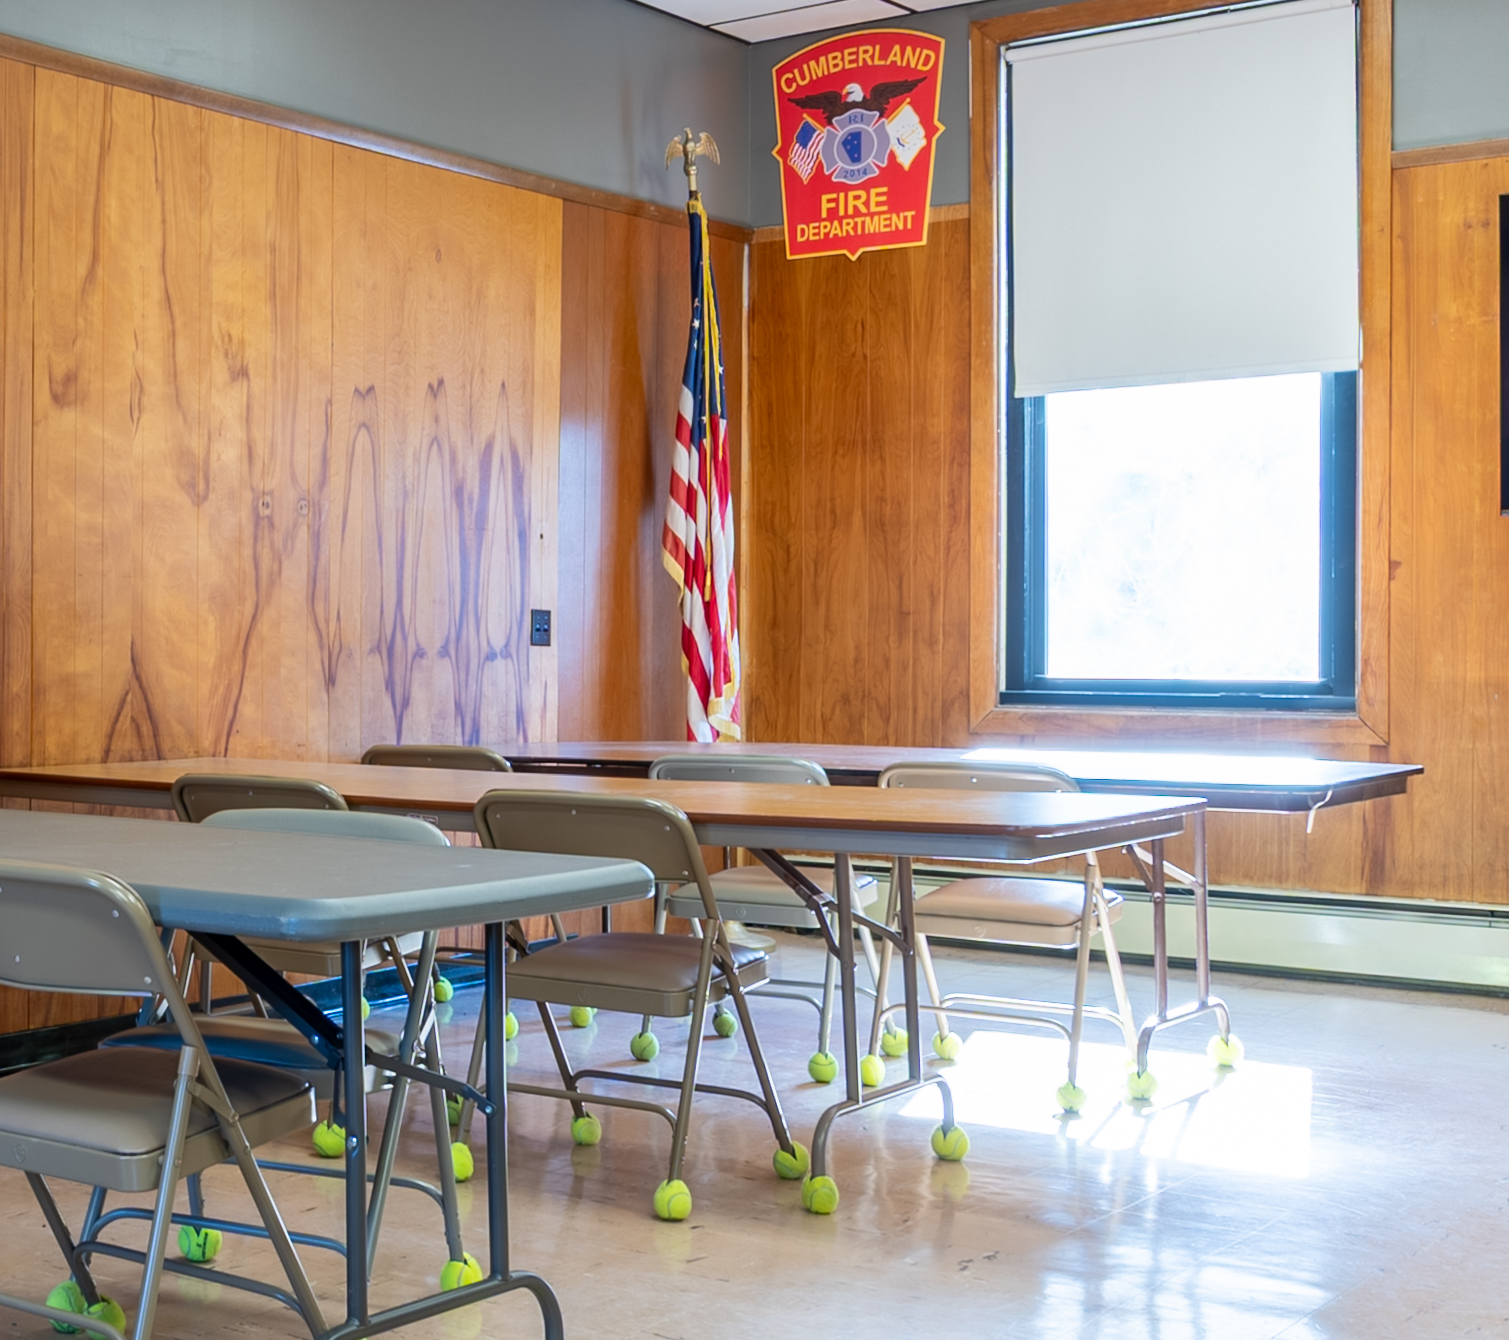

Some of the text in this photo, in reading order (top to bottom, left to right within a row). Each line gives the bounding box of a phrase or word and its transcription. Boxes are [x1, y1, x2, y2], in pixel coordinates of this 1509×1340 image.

[781, 45, 935, 93] CUMBERLAND
[849, 114, 864, 124] RI
[843, 167, 867, 179] 2014
[821, 187, 888, 218] FIRE
[798, 211, 915, 242] DEPARTMENT
